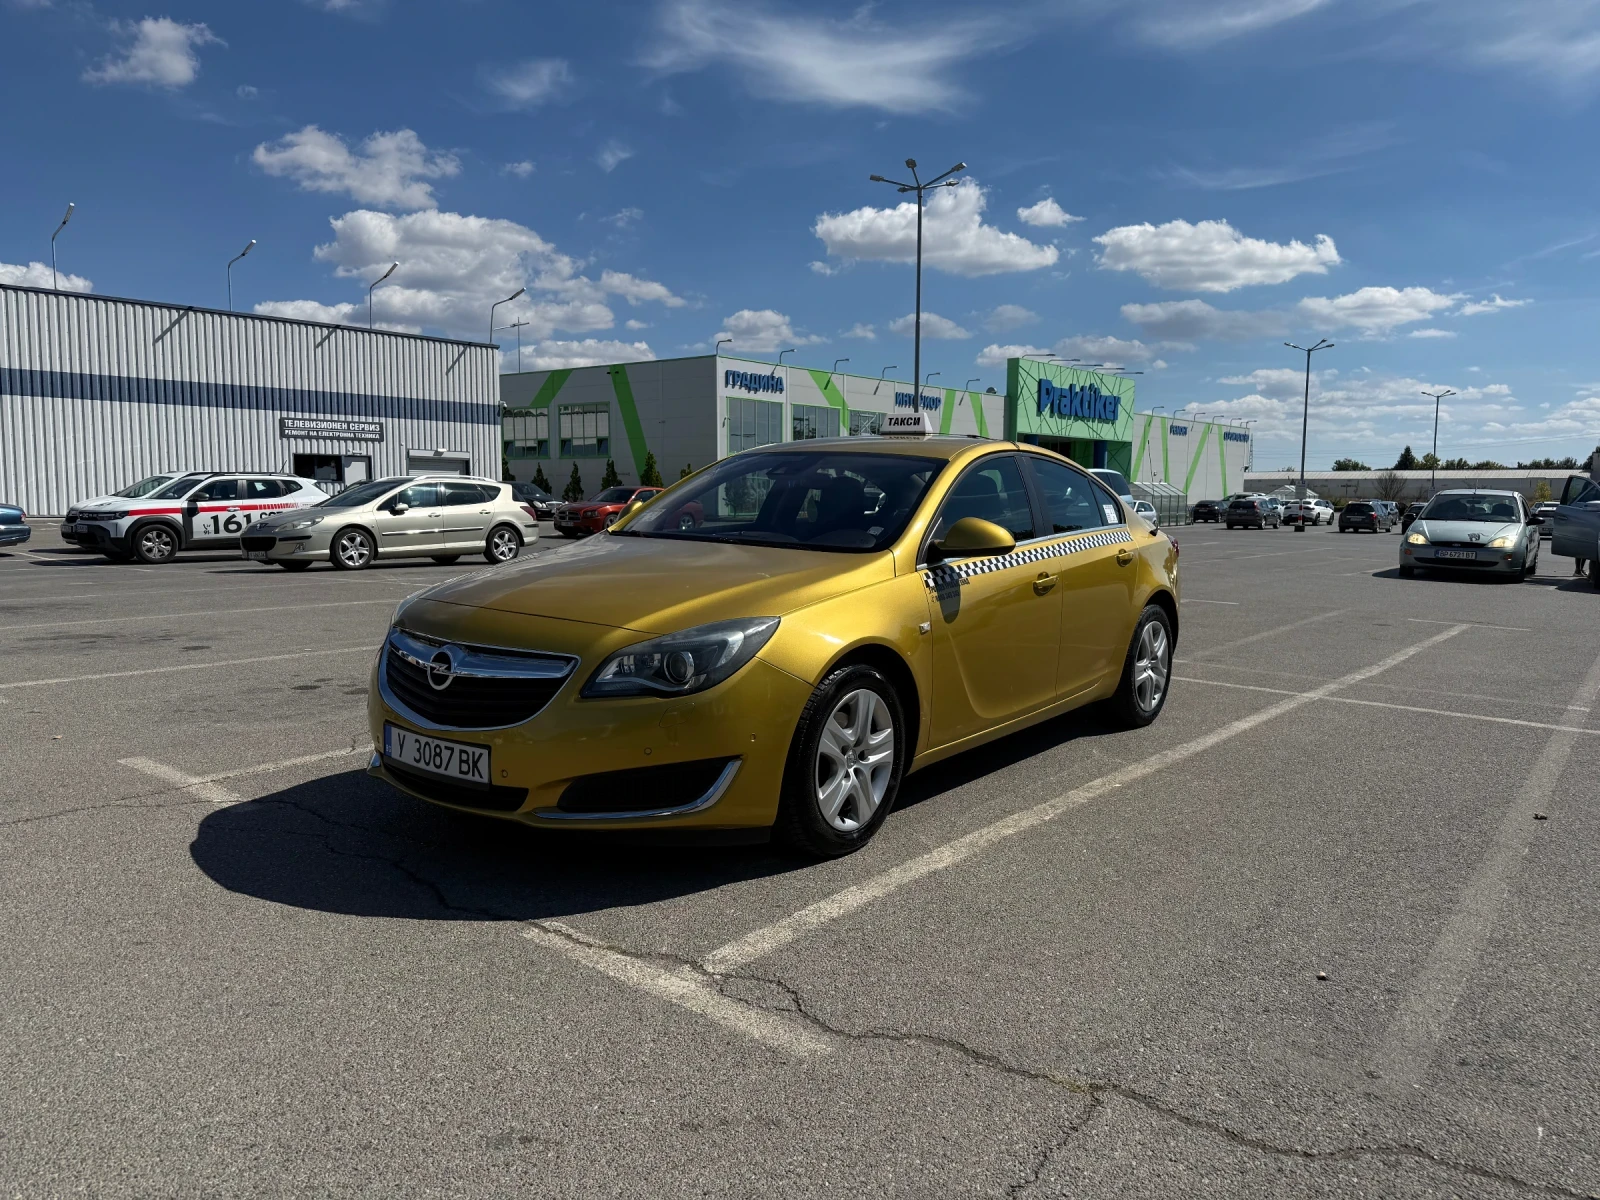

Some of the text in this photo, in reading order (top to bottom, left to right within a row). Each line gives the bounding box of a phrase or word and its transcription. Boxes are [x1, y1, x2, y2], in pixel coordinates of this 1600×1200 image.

[725, 370, 785, 394] ГРАДИНА
[895, 392, 942, 411] ИНТРИОР
[1038, 378, 1121, 421] Praktiker
[284, 419, 380, 431] ТЕЛЕВИЗИОНЕН СЕРВИЗ
[888, 417, 921, 426] ТАКСИ
[211, 513, 252, 535] 161
[413, 738, 455, 772] 3087
[459, 748, 484, 779] BK
